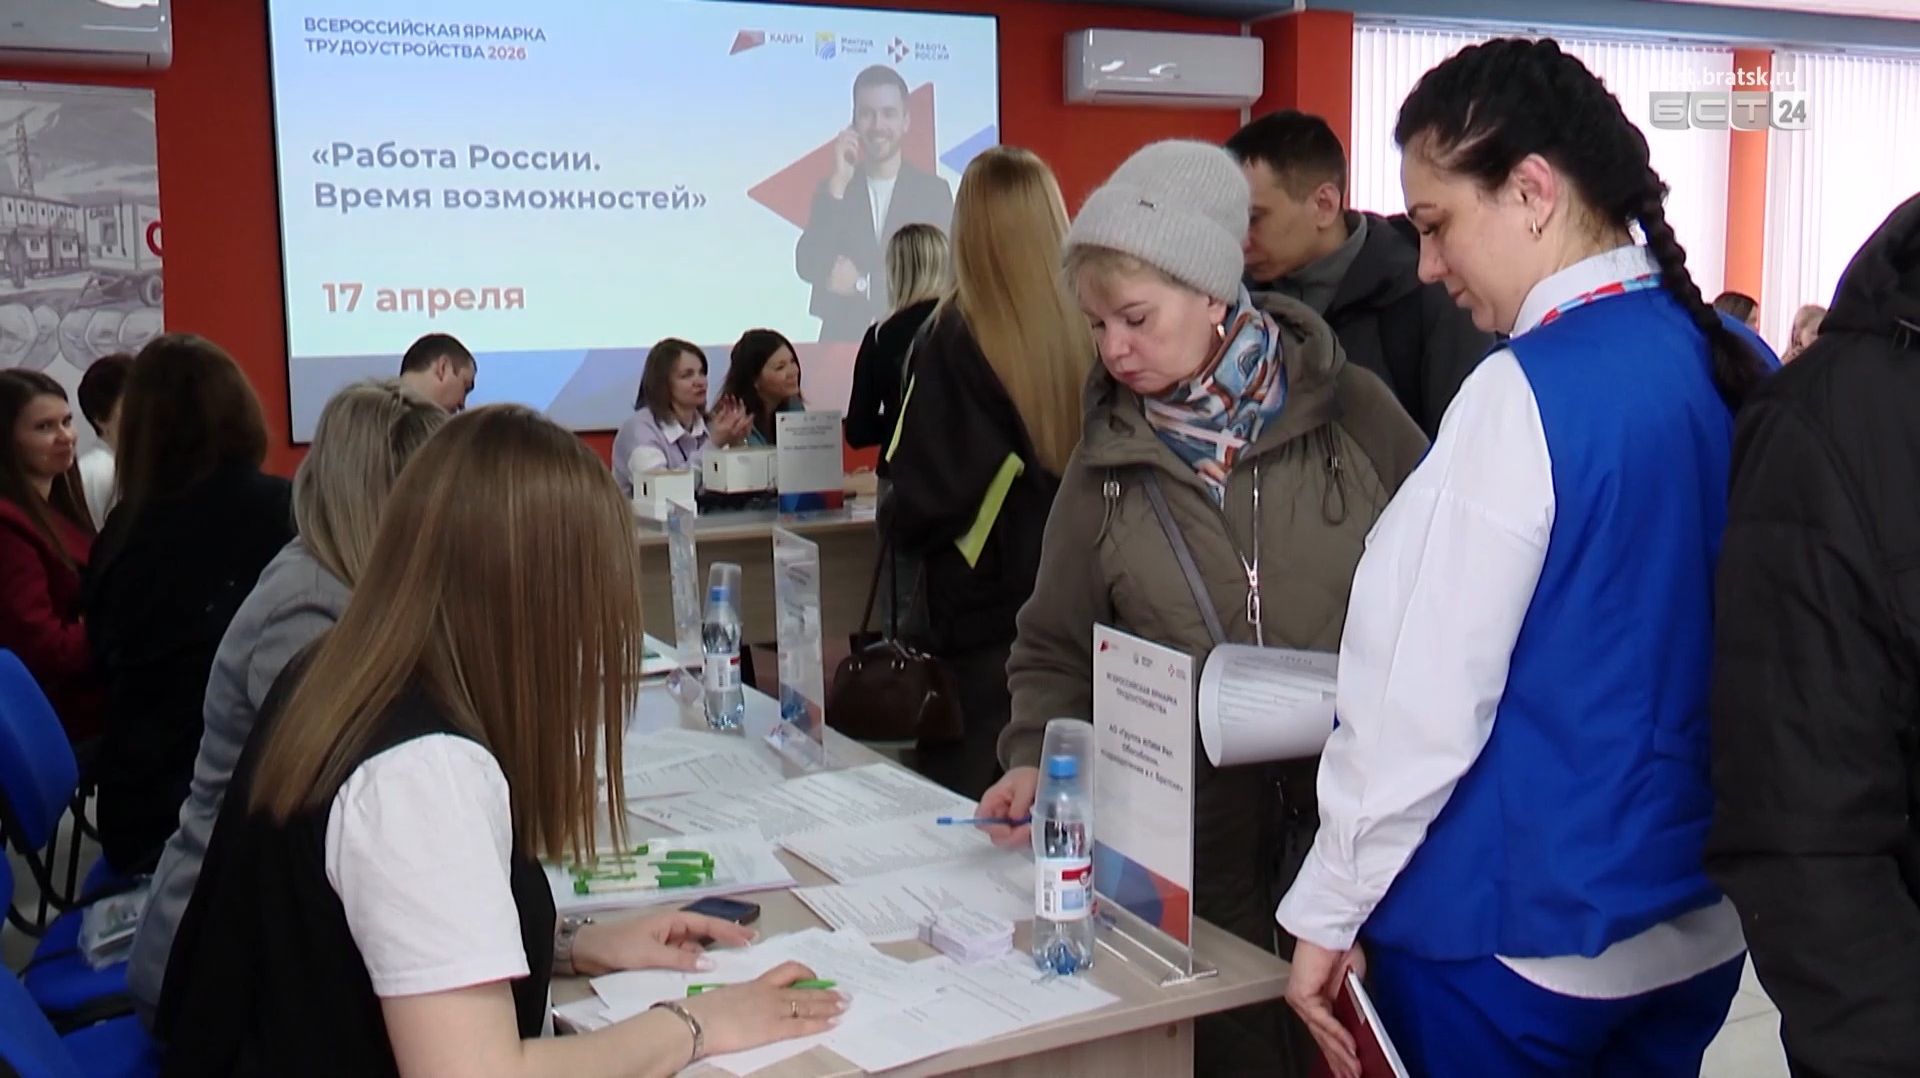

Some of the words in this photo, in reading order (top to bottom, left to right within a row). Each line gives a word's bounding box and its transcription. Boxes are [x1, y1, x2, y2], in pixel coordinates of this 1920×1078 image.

[304, 17, 460, 37] ВСЕРОССИЙСКАЯ
[463, 25, 546, 41] ЯРМАРКА
[304, 37, 486, 59] ТРУДОУСТРОЙСТВА
[487, 45, 527, 60] 2026
[312, 141, 457, 168] «Работа
[469, 144, 601, 171] России.
[314, 182, 432, 213] Время
[443, 184, 707, 211] возможностей»
[322, 283, 363, 313] 17
[375, 287, 525, 319] апреля
